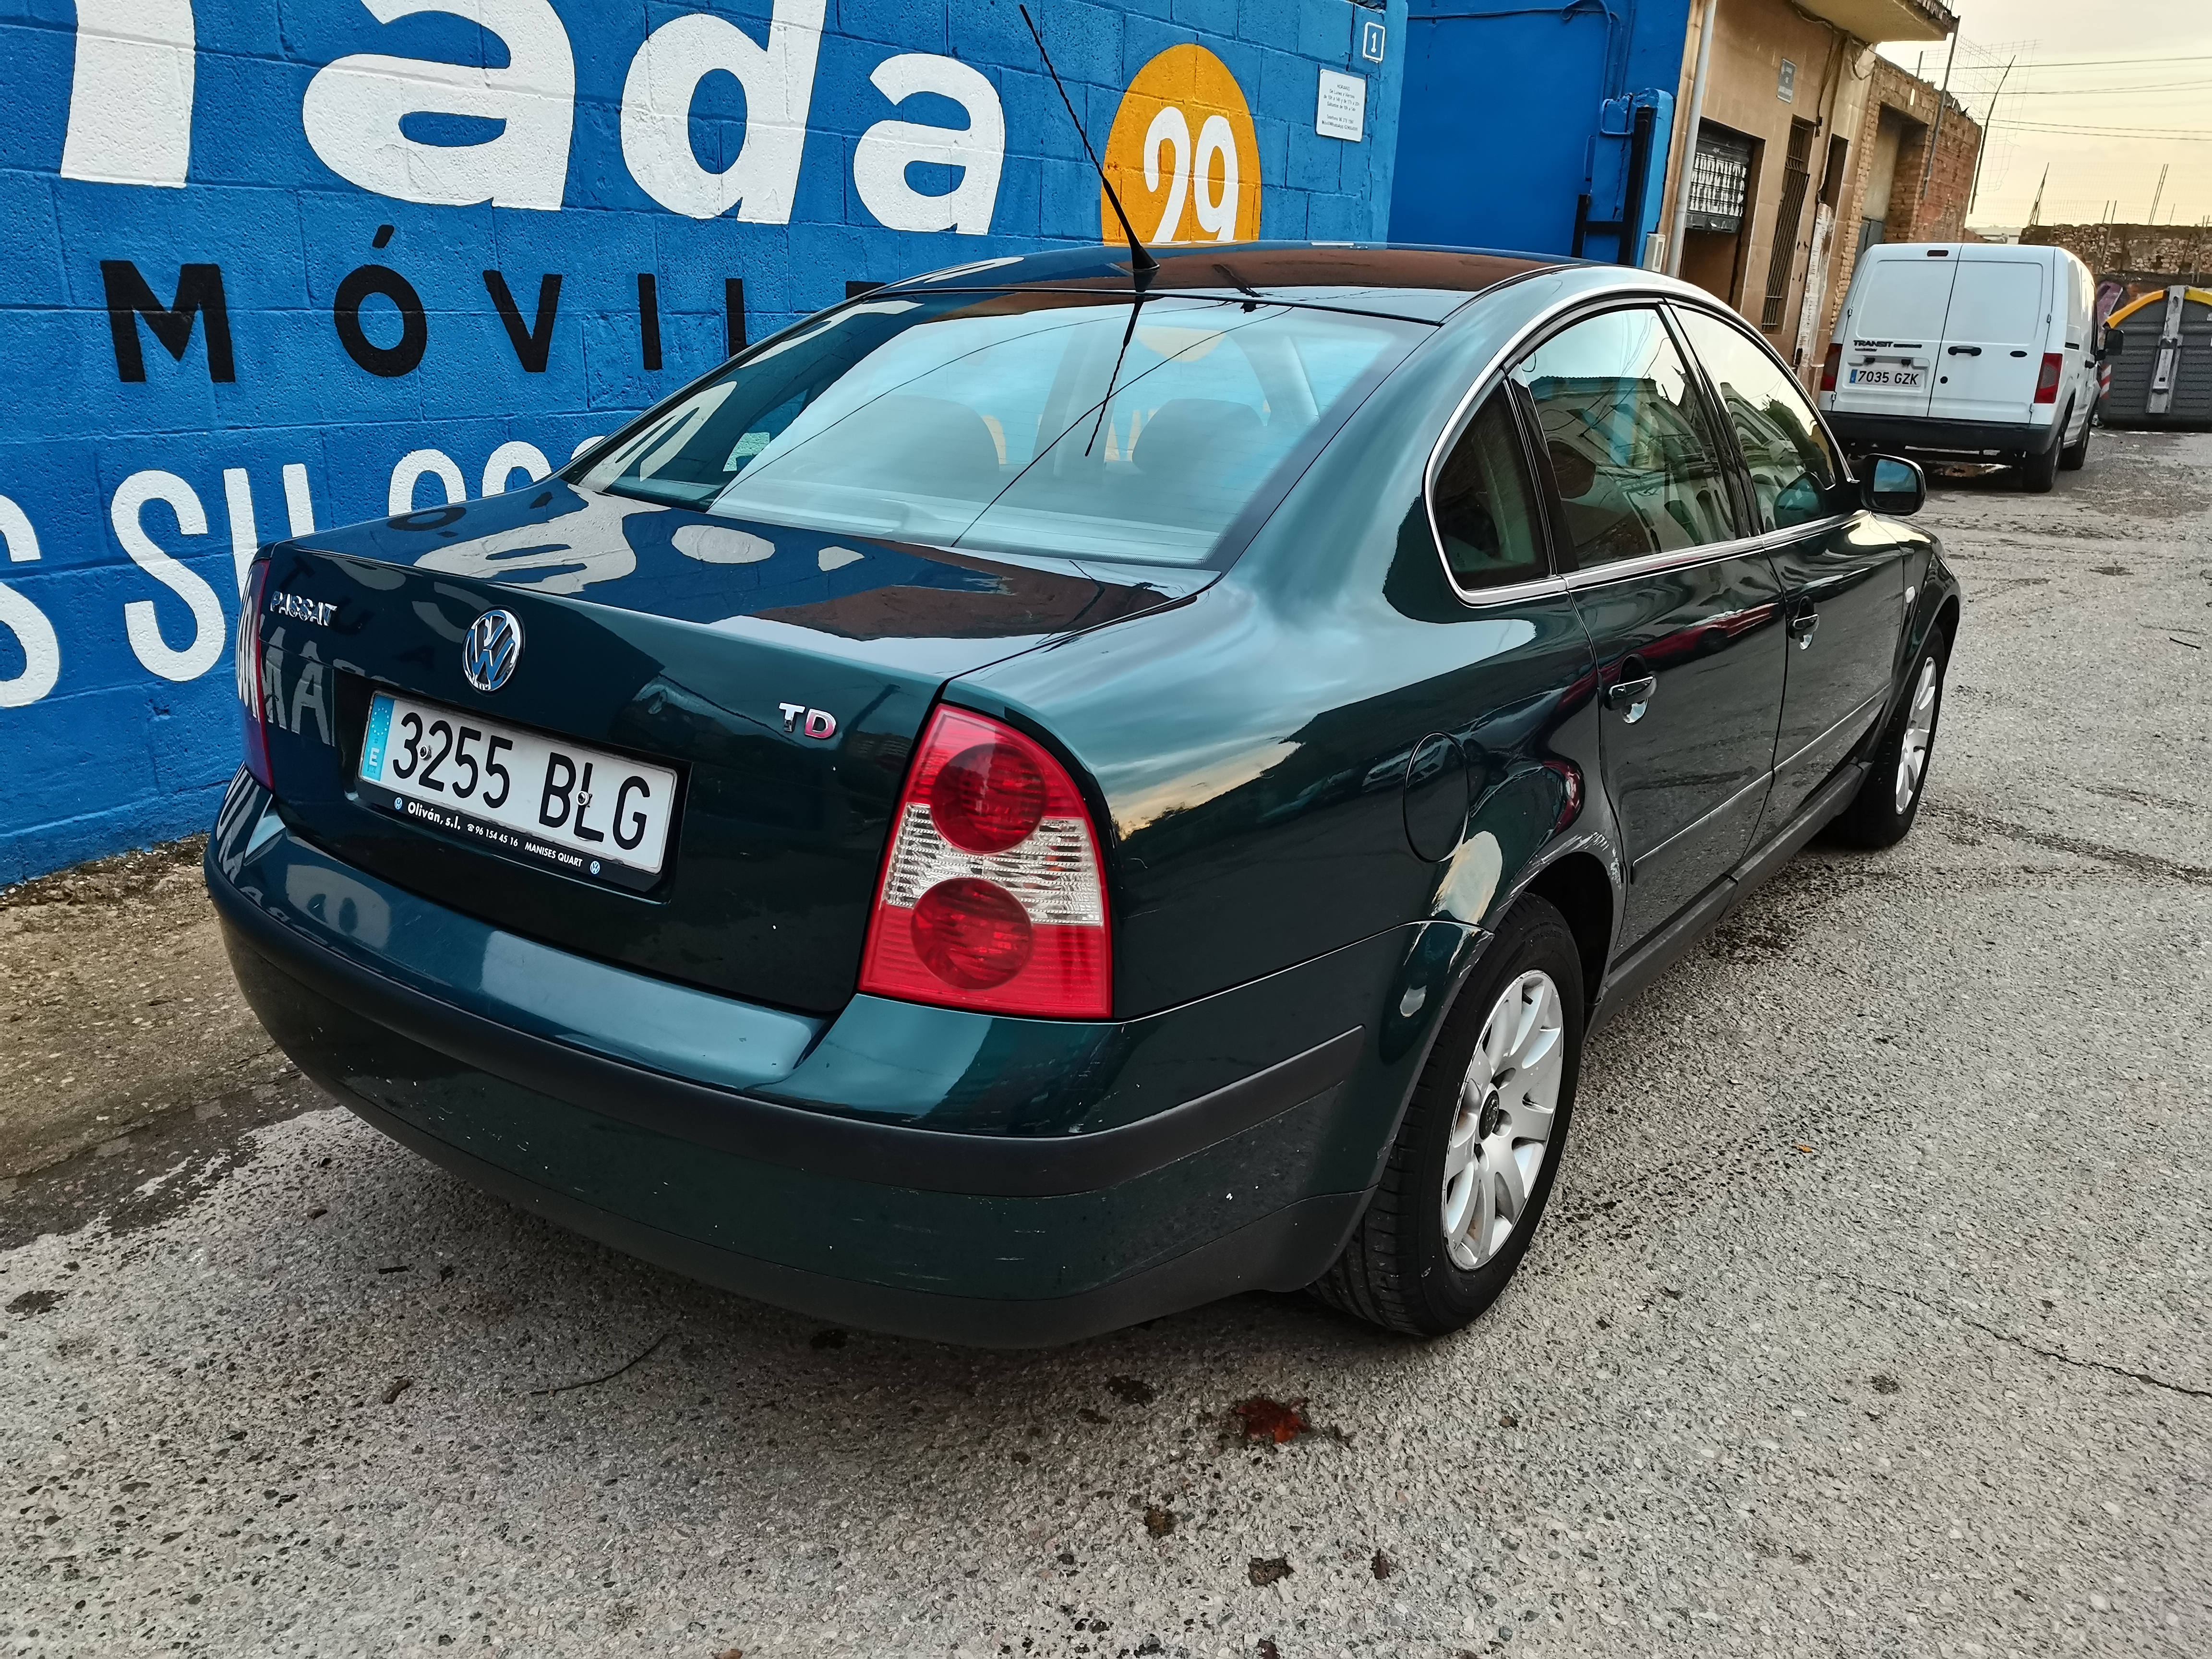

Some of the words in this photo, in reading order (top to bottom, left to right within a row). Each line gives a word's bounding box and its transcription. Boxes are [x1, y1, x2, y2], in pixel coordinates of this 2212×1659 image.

[100, 225, 887, 383] MÓVIL
[1858, 371, 1889, 383] 7035
[1894, 373, 1919, 385] GZK
[270, 591, 337, 626] PASSAT
[779, 702, 836, 739] TD
[393, 712, 513, 808] 3255
[539, 752, 651, 850] BLG
[408, 801, 444, 825] Oliván,
[445, 816, 461, 830] s.l.
[475, 826, 484, 836] 96
[486, 829, 497, 840] 154
[499, 834, 508, 843] 45
[510, 837, 518, 847] 16
[525, 842, 556, 859] MANISES
[558, 853, 583, 867] QUART
